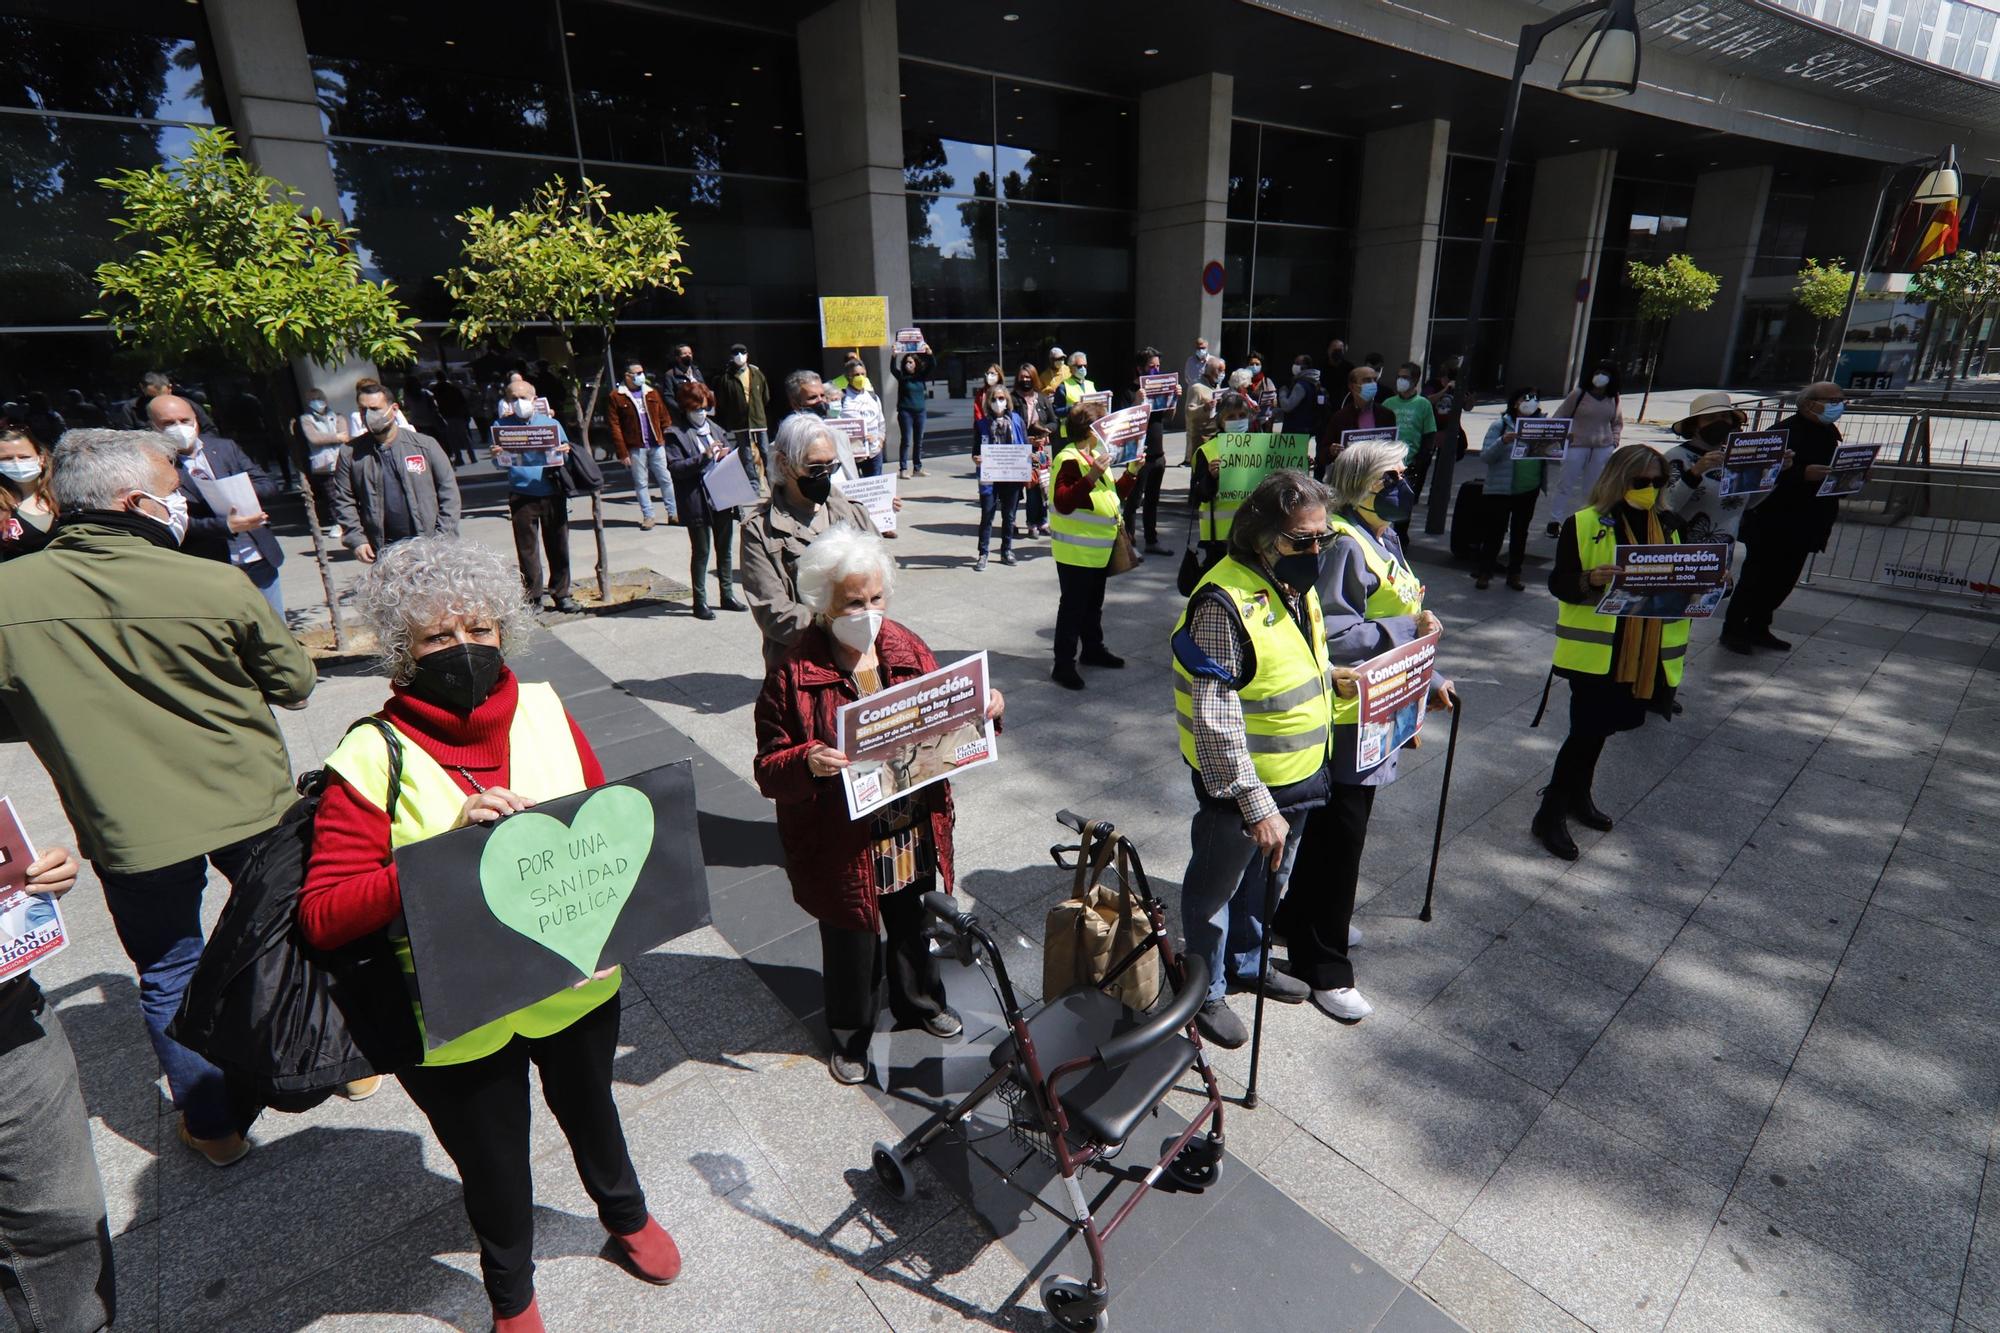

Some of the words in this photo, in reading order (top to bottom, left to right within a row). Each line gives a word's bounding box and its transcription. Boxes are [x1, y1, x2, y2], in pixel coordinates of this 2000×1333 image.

[1649, 4, 1783, 60] REINA
[1226, 433, 1252, 448] POR
[1269, 434, 1296, 449] UNA
[1220, 453, 1263, 469] SANIDAD
[1265, 451, 1304, 469] PÚBLICA
[1628, 551, 1719, 563] Concentración.
[1684, 563, 1699, 573] hay
[1699, 563, 1720, 571] salud
[1884, 567, 1968, 587] INTERSINDICAL
[859, 675, 974, 725] Concentración.
[857, 725, 873, 738] Sin
[920, 704, 932, 715] no
[933, 699, 950, 712] hay
[951, 688, 974, 704] salud
[859, 734, 884, 748] Sábado
[884, 730, 891, 738] 17
[891, 727, 899, 736] de
[924, 711, 948, 725] 12:00h
[956, 741, 976, 754] PLAN
[956, 744, 988, 760] CHOQUE
[517, 849, 554, 881] POR
[568, 832, 608, 860] UNA
[530, 857, 629, 907] SANIDAD
[0, 930, 36, 954] LAN
[35, 939, 60, 955] MURCIA
